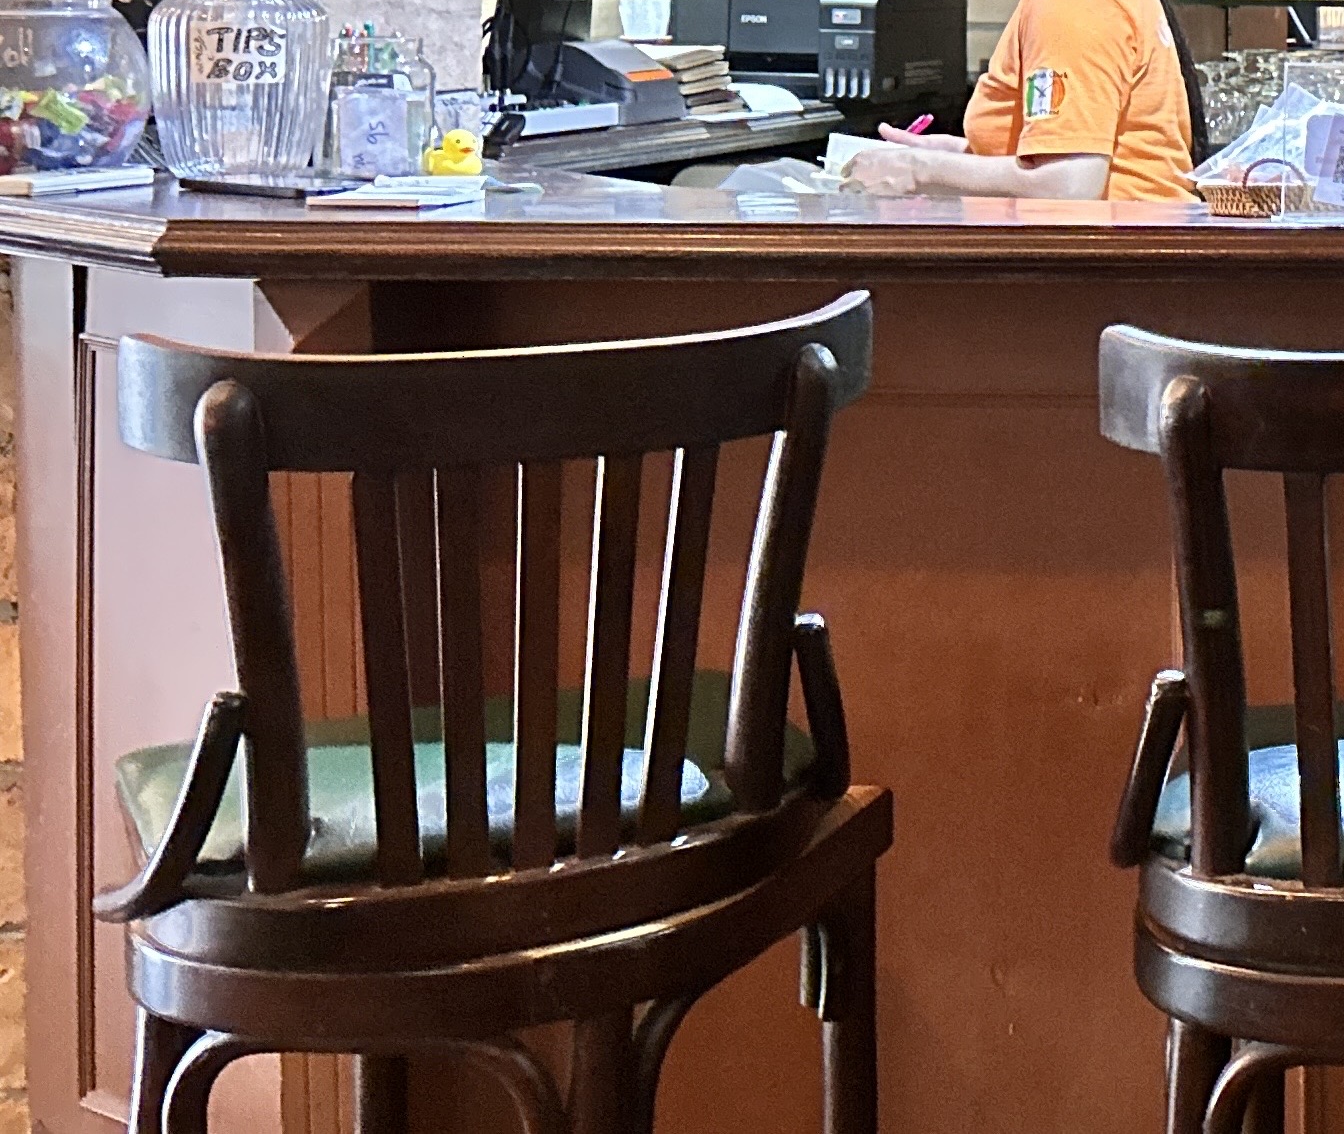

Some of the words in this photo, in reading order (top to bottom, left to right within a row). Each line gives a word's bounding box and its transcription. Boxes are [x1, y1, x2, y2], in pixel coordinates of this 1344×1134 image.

[741, 14, 768, 24] EPSON
[206, 26, 286, 57] TIPS
[206, 58, 278, 82] BOX
